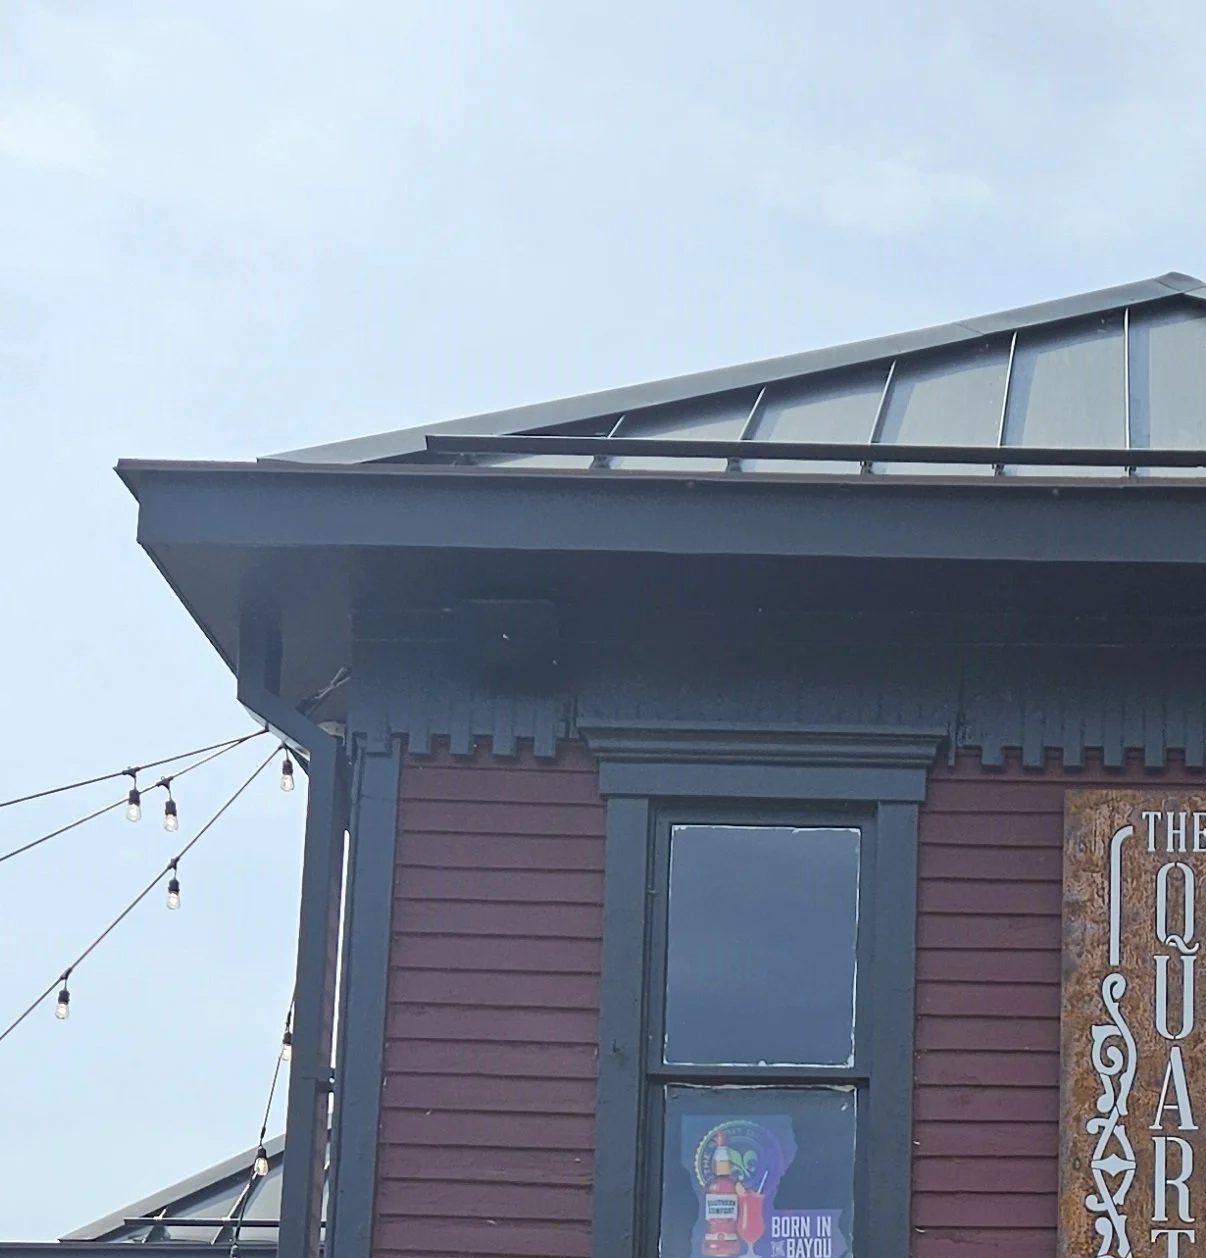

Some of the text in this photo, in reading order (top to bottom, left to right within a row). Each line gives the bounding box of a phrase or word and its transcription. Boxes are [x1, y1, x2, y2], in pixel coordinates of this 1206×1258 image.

[771, 1216, 832, 1237] BORN IN
[786, 1238, 832, 1258] BAYOU
